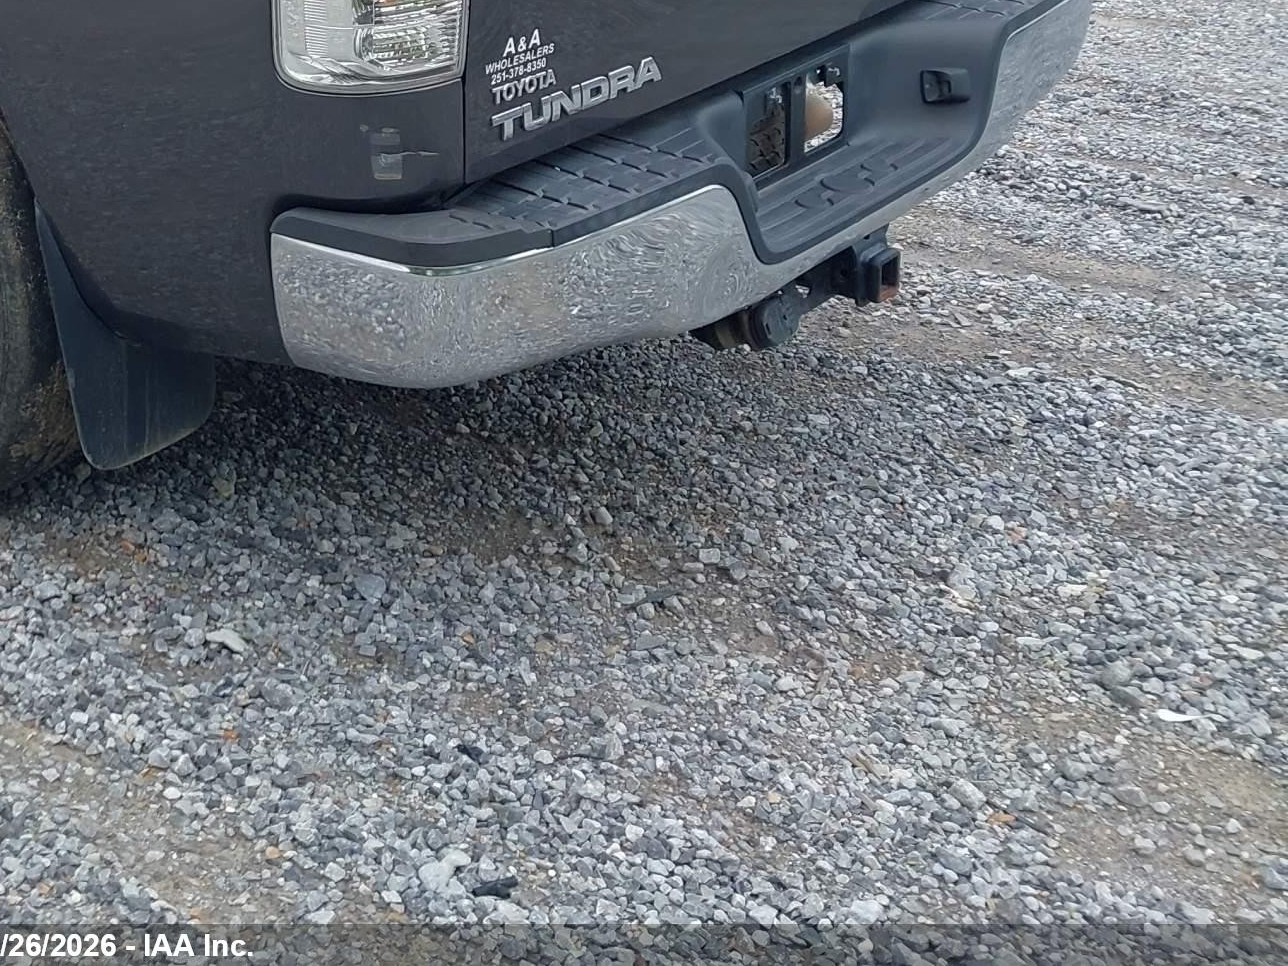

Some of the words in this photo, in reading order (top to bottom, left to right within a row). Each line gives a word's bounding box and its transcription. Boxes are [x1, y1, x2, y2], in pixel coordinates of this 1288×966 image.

[485, 43, 555, 75] WHOLESALERS
[491, 57, 547, 85] 251-378-8350
[491, 69, 557, 105] TOYOTA
[491, 56, 662, 141] TUNDRA
